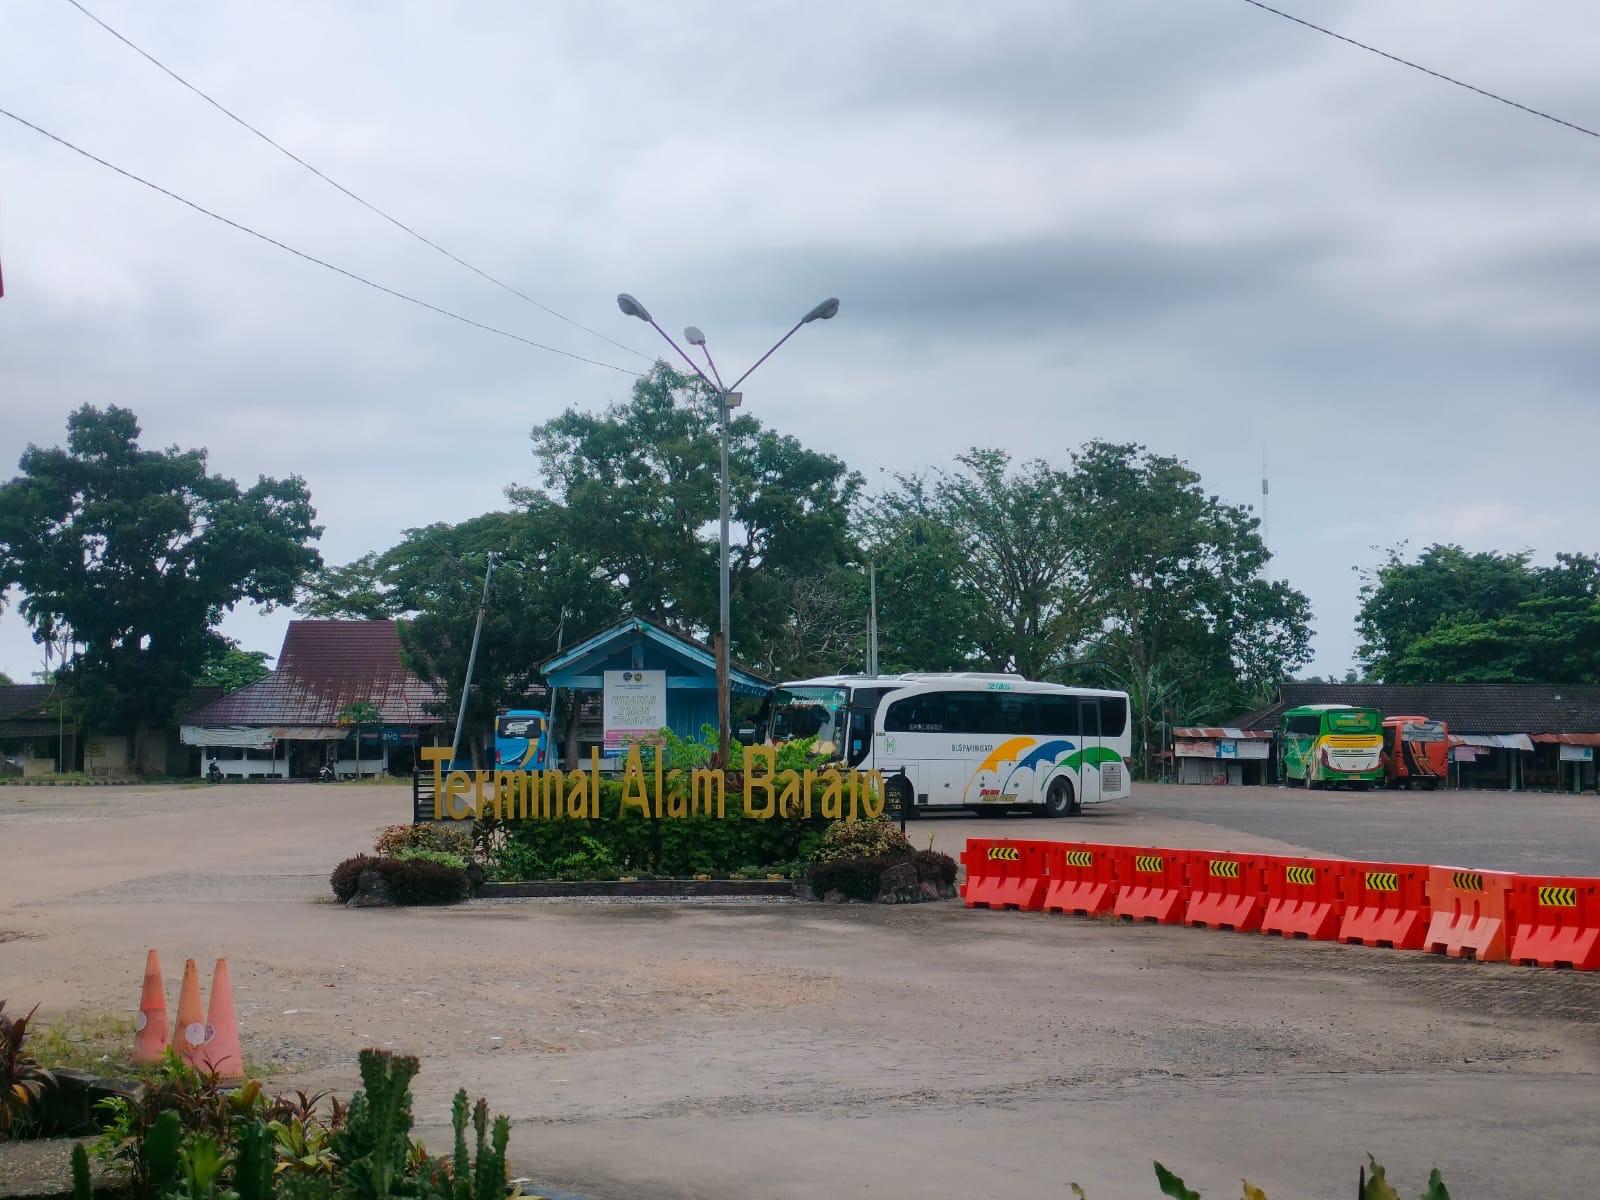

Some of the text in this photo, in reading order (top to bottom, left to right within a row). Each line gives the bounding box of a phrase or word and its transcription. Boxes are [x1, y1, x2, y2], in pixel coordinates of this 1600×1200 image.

[420, 744, 887, 823] Terminal Alam Barajo
